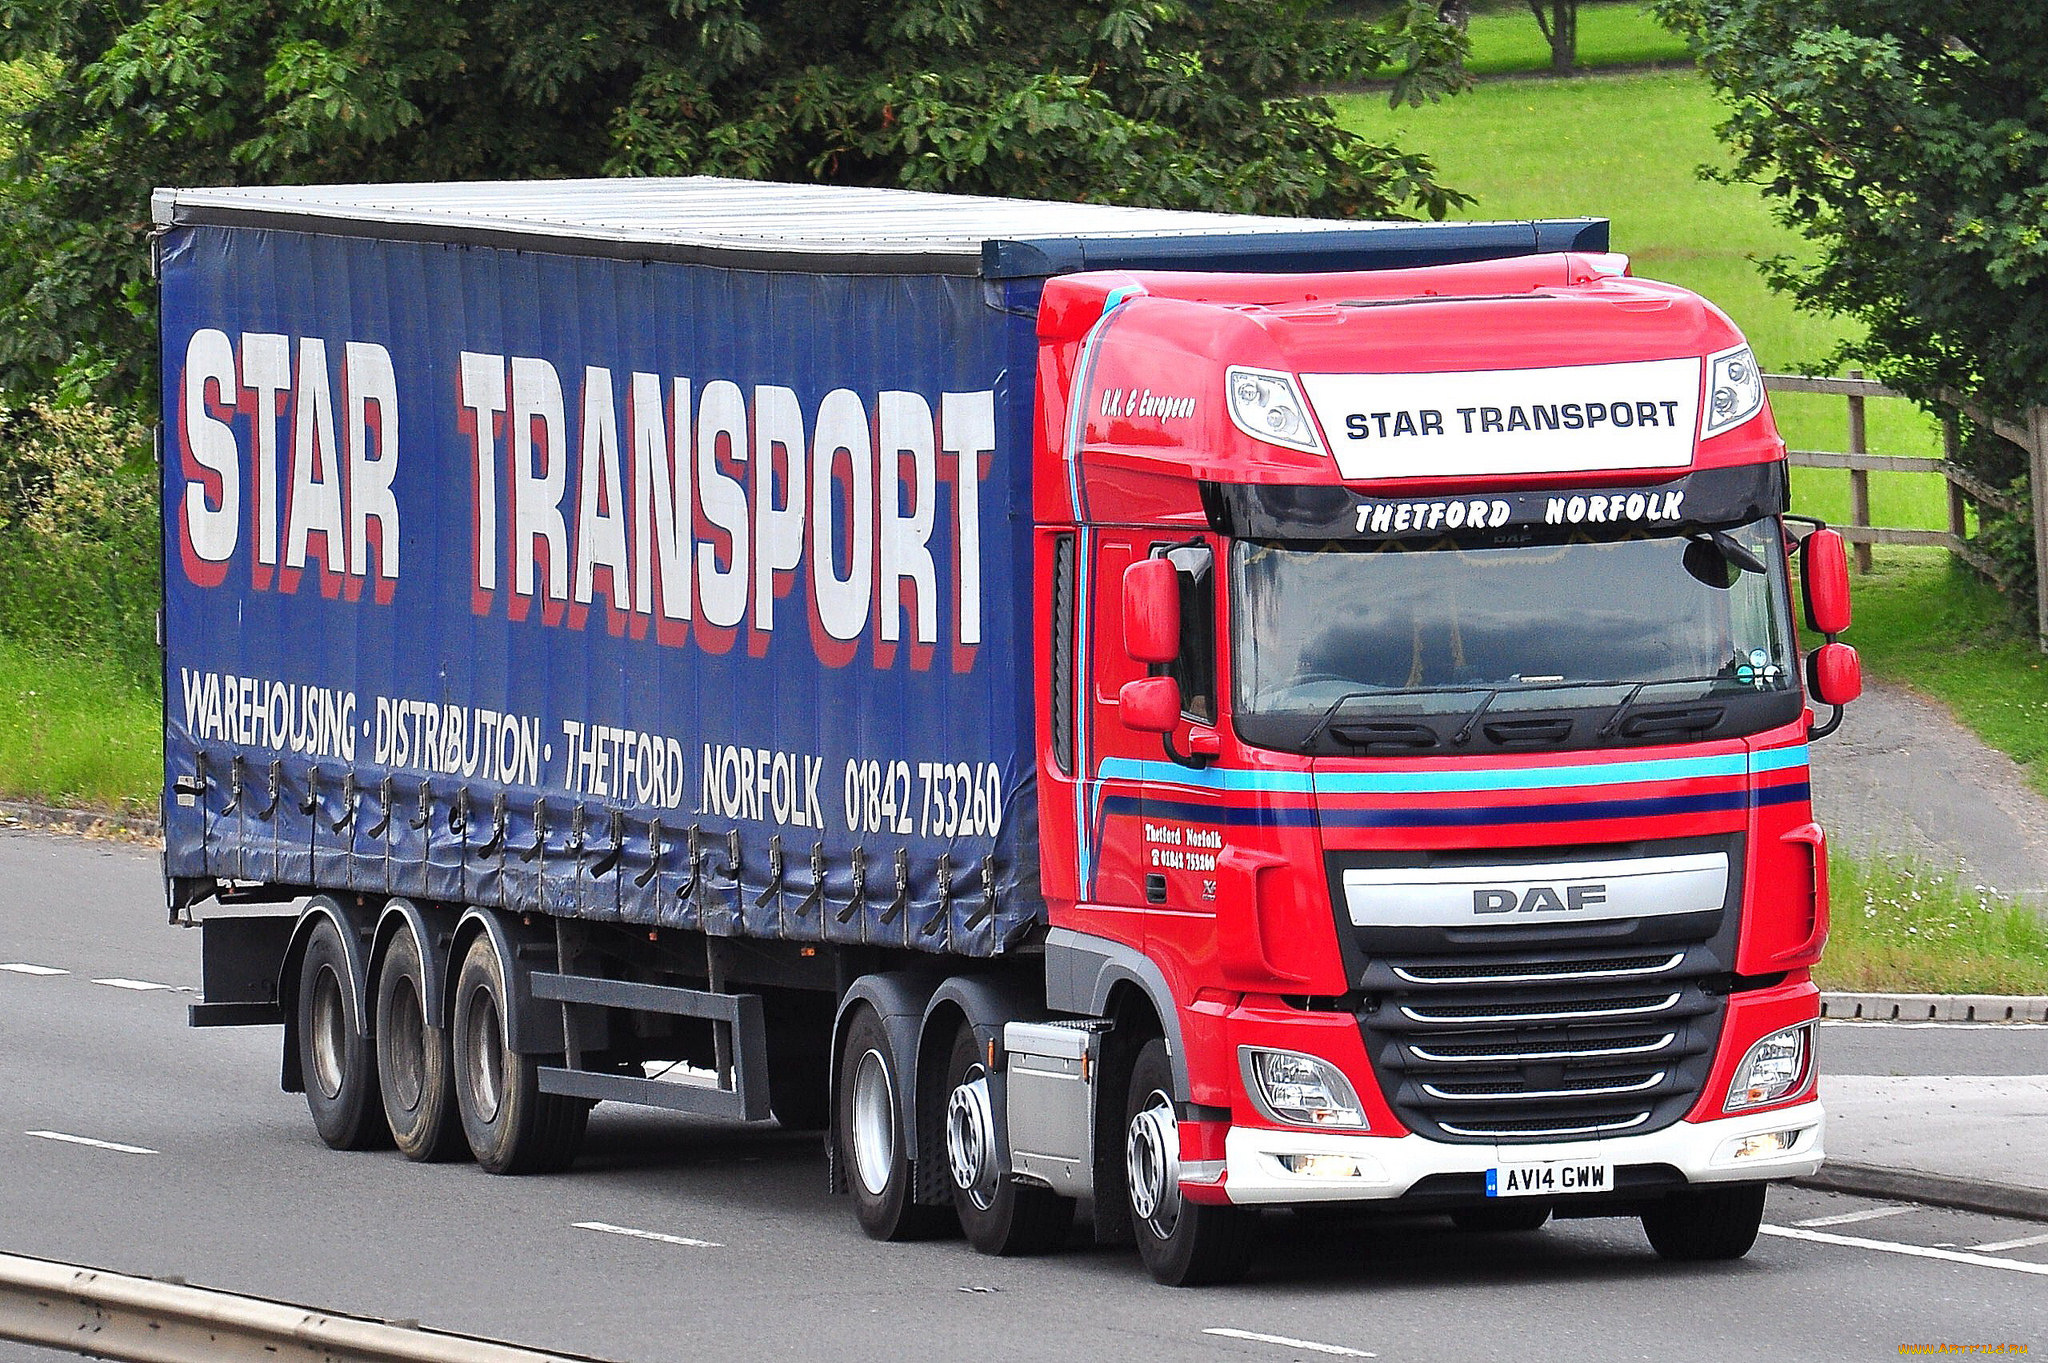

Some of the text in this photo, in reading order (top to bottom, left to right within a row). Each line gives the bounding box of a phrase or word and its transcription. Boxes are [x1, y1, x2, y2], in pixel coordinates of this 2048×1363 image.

[1138, 388, 1196, 425] European
[1345, 401, 1679, 440] STAR TRANSPORT
[178, 328, 996, 673] STAR TRANSPORT
[1354, 490, 1686, 534] THETFORD NORFOLK
[181, 667, 1002, 839] WAREHOUSING DISTRIBUTION THETFORD NORFOLK 01842 753260
[1144, 823, 1222, 849] Thetford Norfolk
[1161, 850, 1216, 872] 01842 753260
[1473, 884, 1606, 914] DAF
[1506, 1165, 1605, 1191] AV14 GWW
